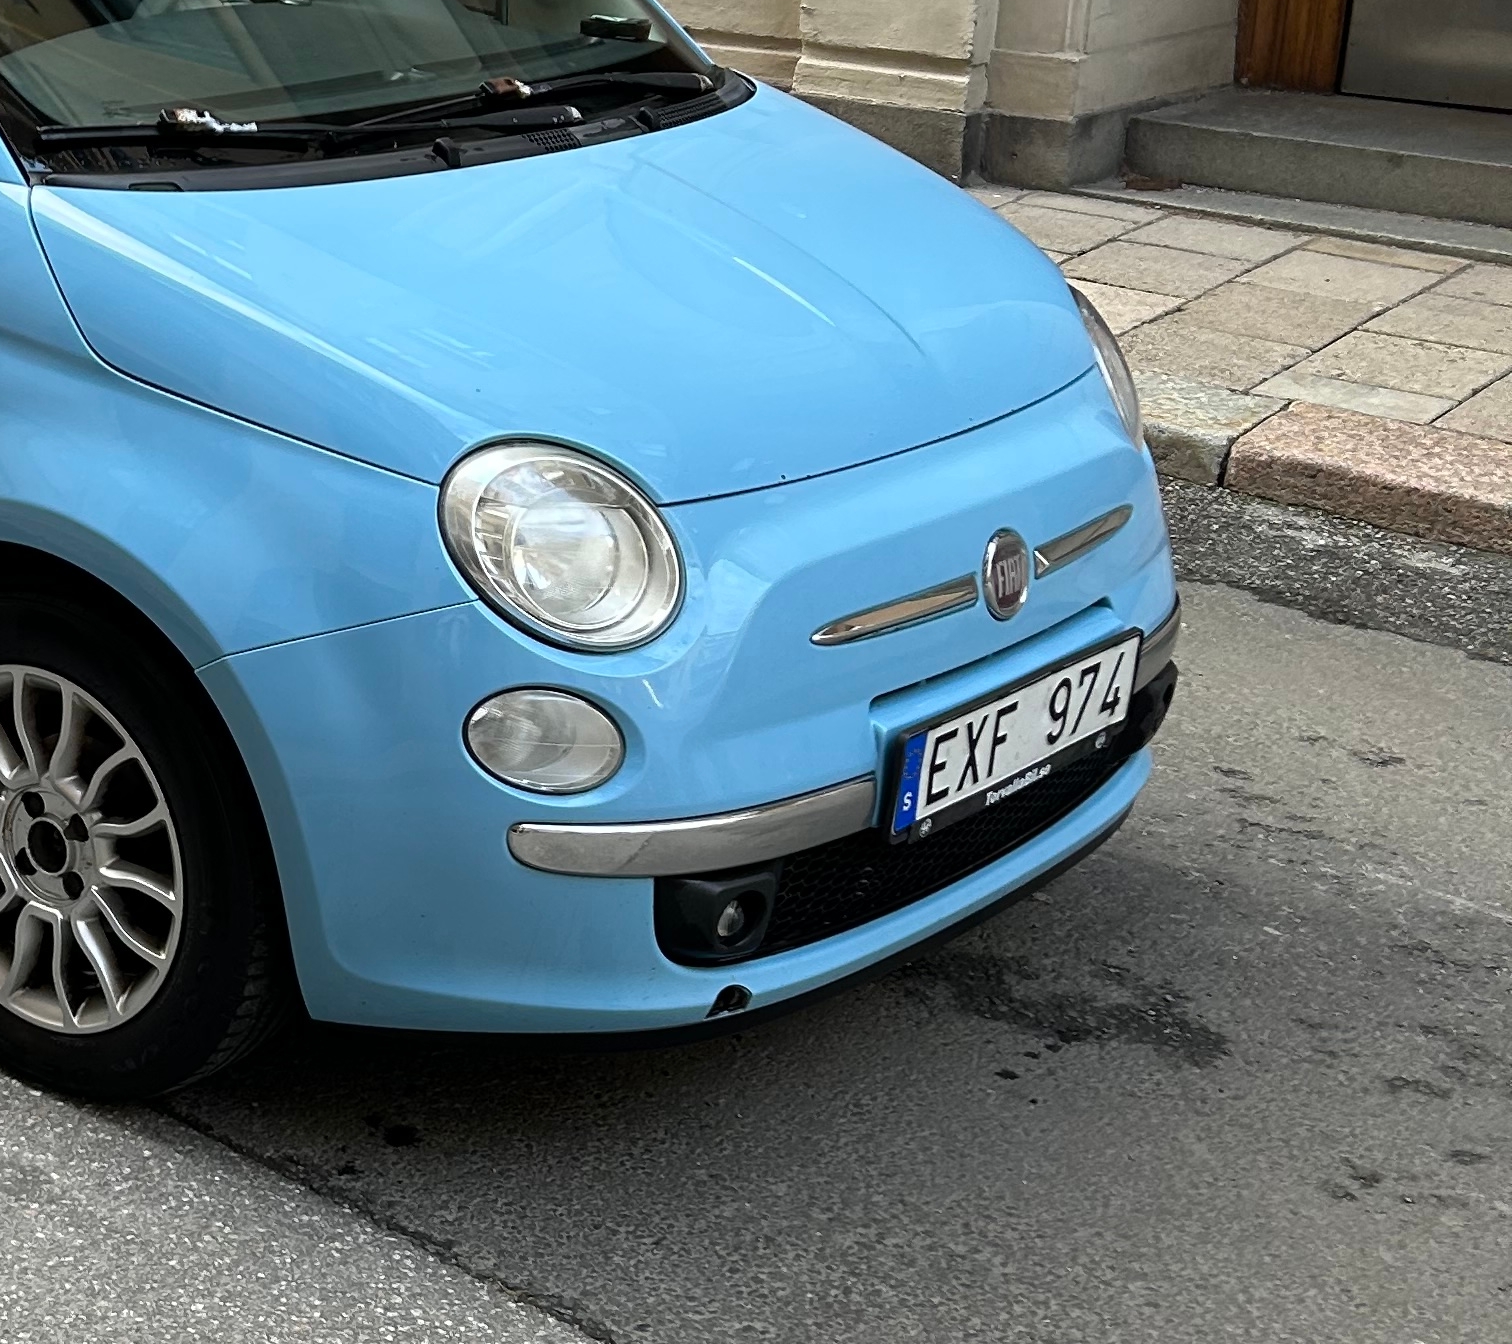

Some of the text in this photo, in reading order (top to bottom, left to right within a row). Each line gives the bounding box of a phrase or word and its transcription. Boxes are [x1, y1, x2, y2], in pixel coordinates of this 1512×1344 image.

[924, 651, 1126, 807] EXF 974
[901, 791, 913, 812] S
